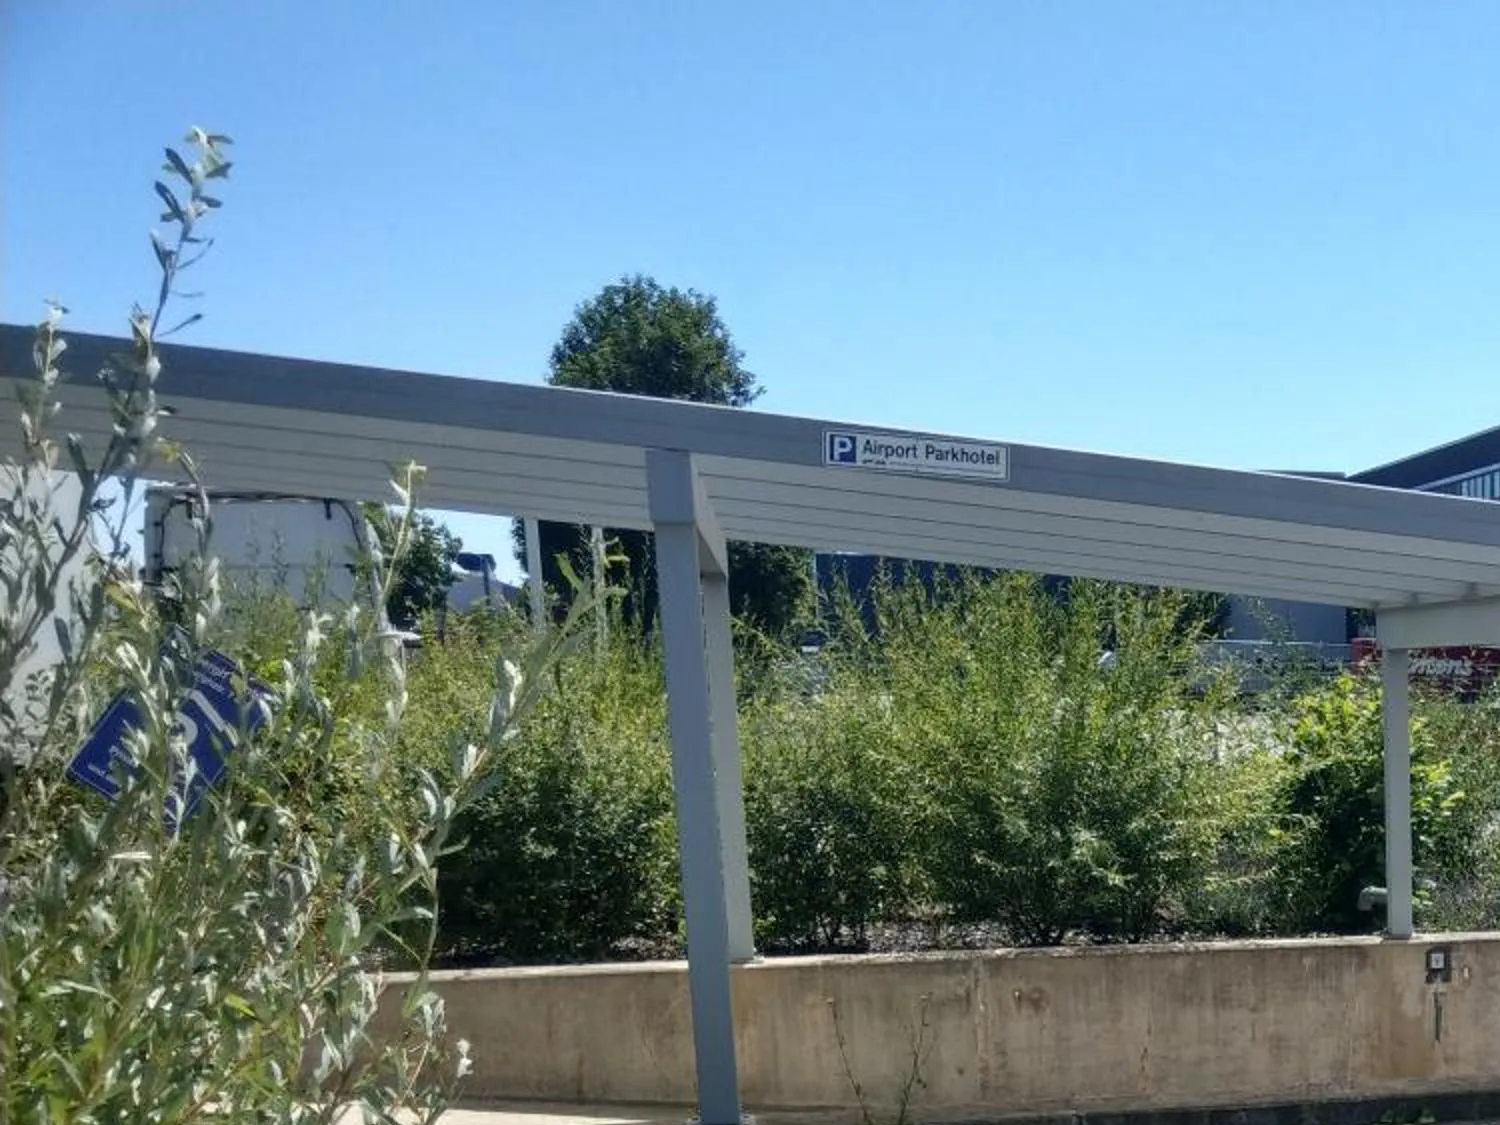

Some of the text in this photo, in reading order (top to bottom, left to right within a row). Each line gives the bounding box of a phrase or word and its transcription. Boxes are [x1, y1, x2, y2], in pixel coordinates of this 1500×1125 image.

[834, 436, 1000, 465] P Airport Parkhotel
